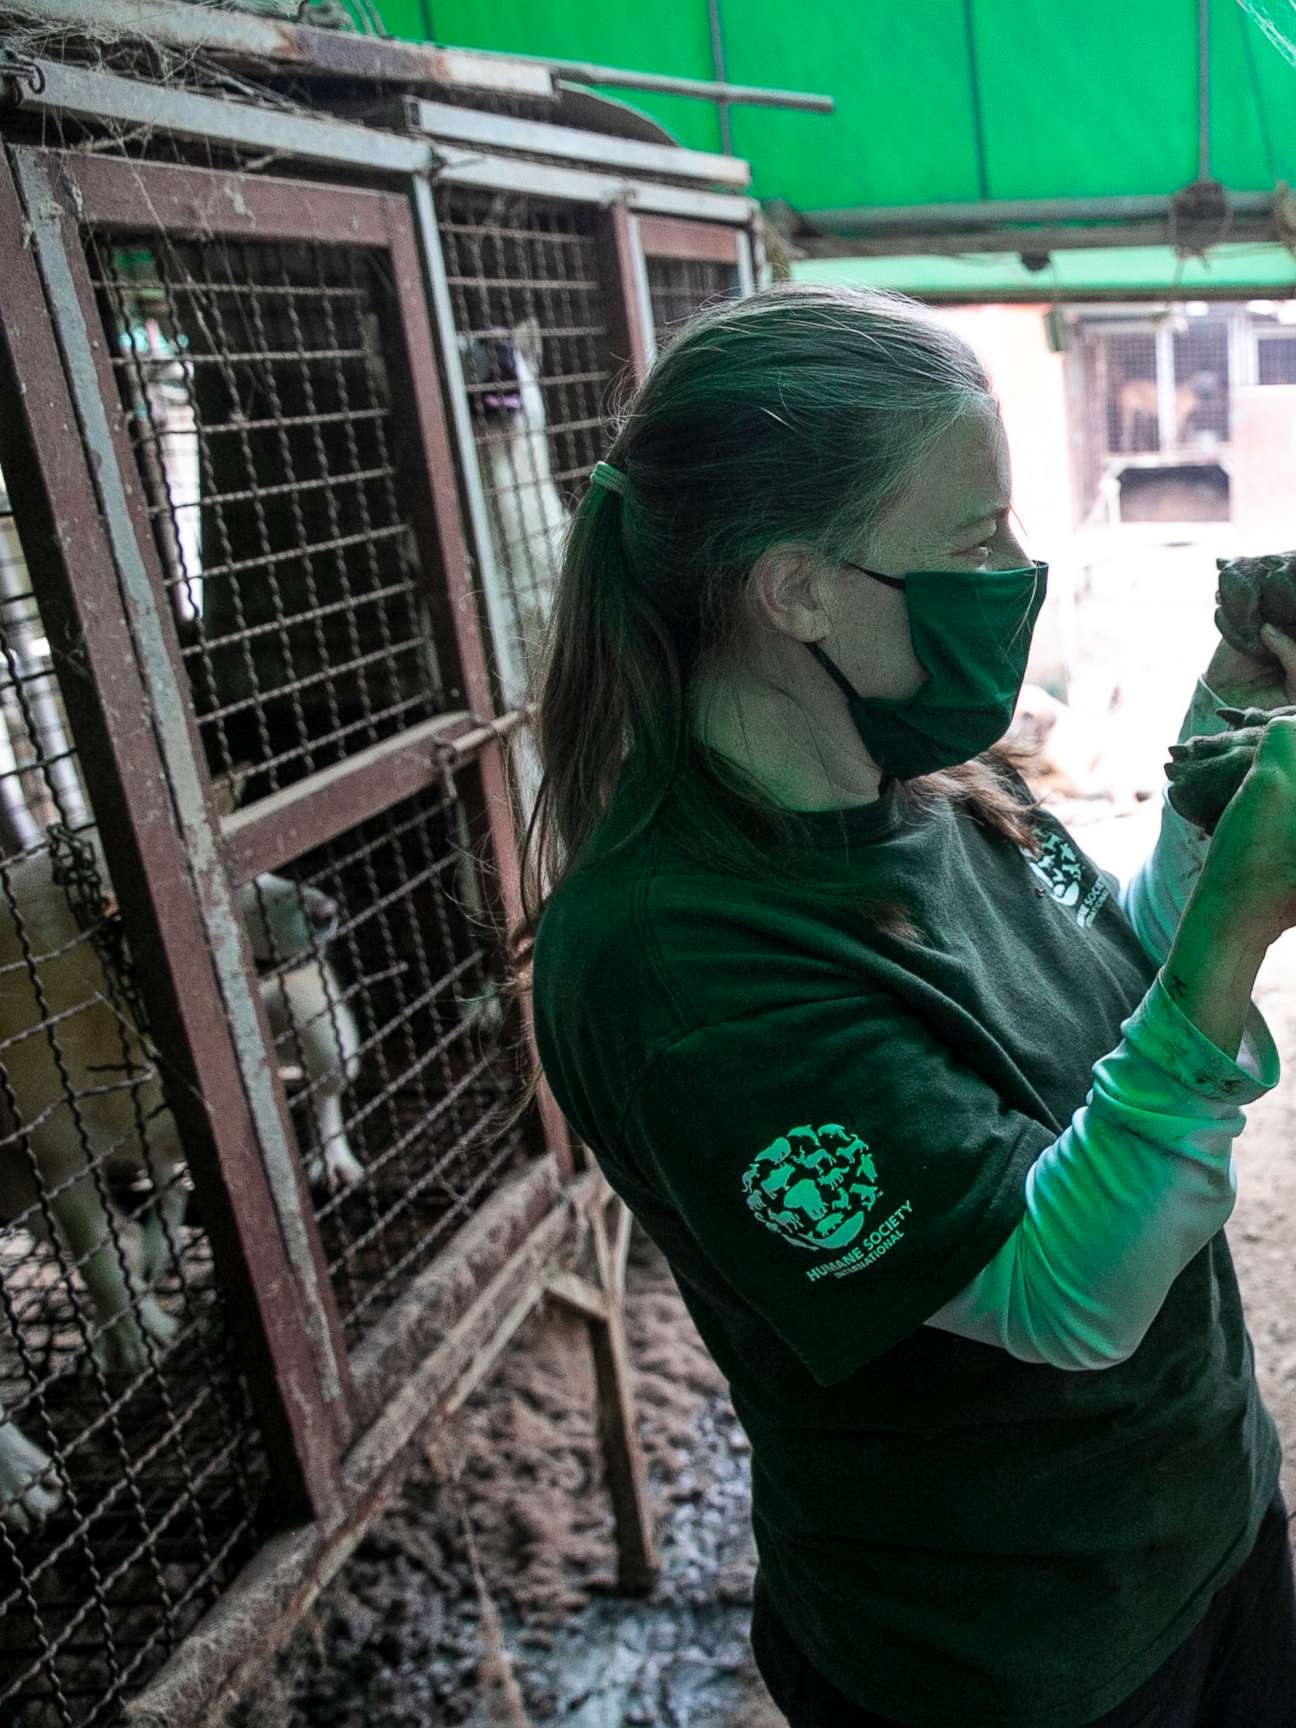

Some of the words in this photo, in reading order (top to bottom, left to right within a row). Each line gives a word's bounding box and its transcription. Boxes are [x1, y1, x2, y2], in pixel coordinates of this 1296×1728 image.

[806, 1247, 864, 1281] HUMANE
[863, 1199, 913, 1250] SOCIETY
[834, 1230, 904, 1279] INTERNATIONAL
